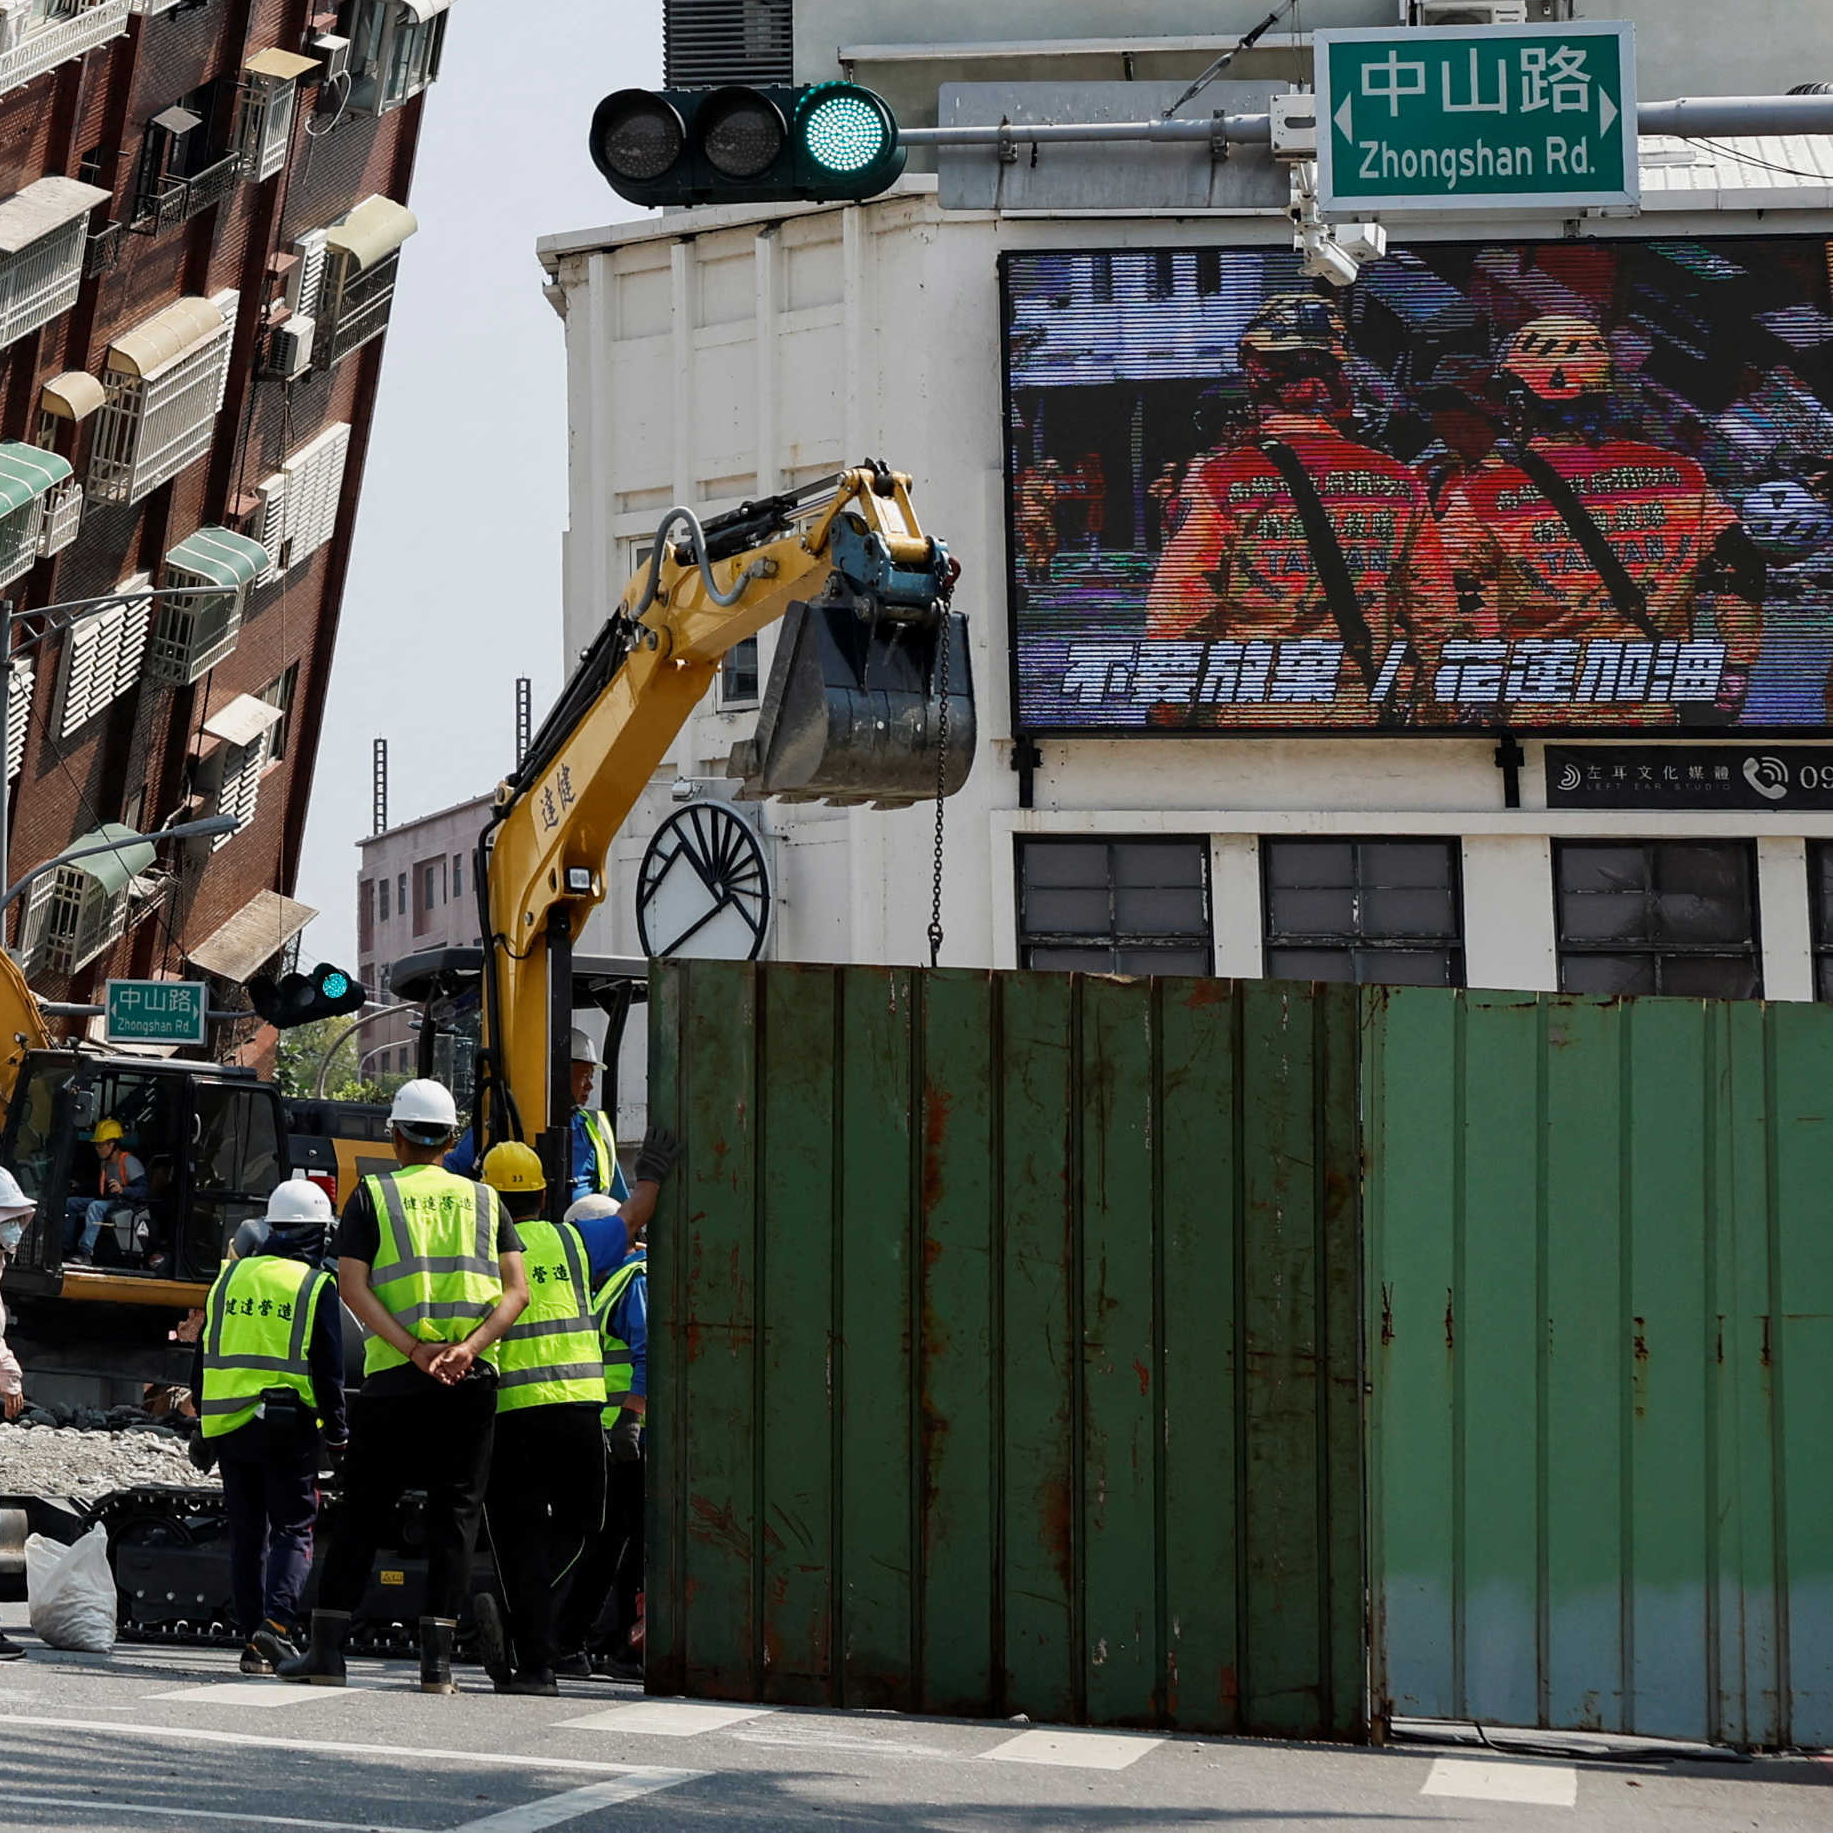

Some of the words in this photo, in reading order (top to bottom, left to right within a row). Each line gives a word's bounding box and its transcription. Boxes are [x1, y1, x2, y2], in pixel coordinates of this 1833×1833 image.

[1360, 46, 1591, 117] 中山路
[1358, 138, 1533, 190] Zhongshan
[1545, 137, 1596, 175] Rd.
[119, 987, 191, 1012] 中山路
[117, 1017, 173, 1036] Zhongshan
